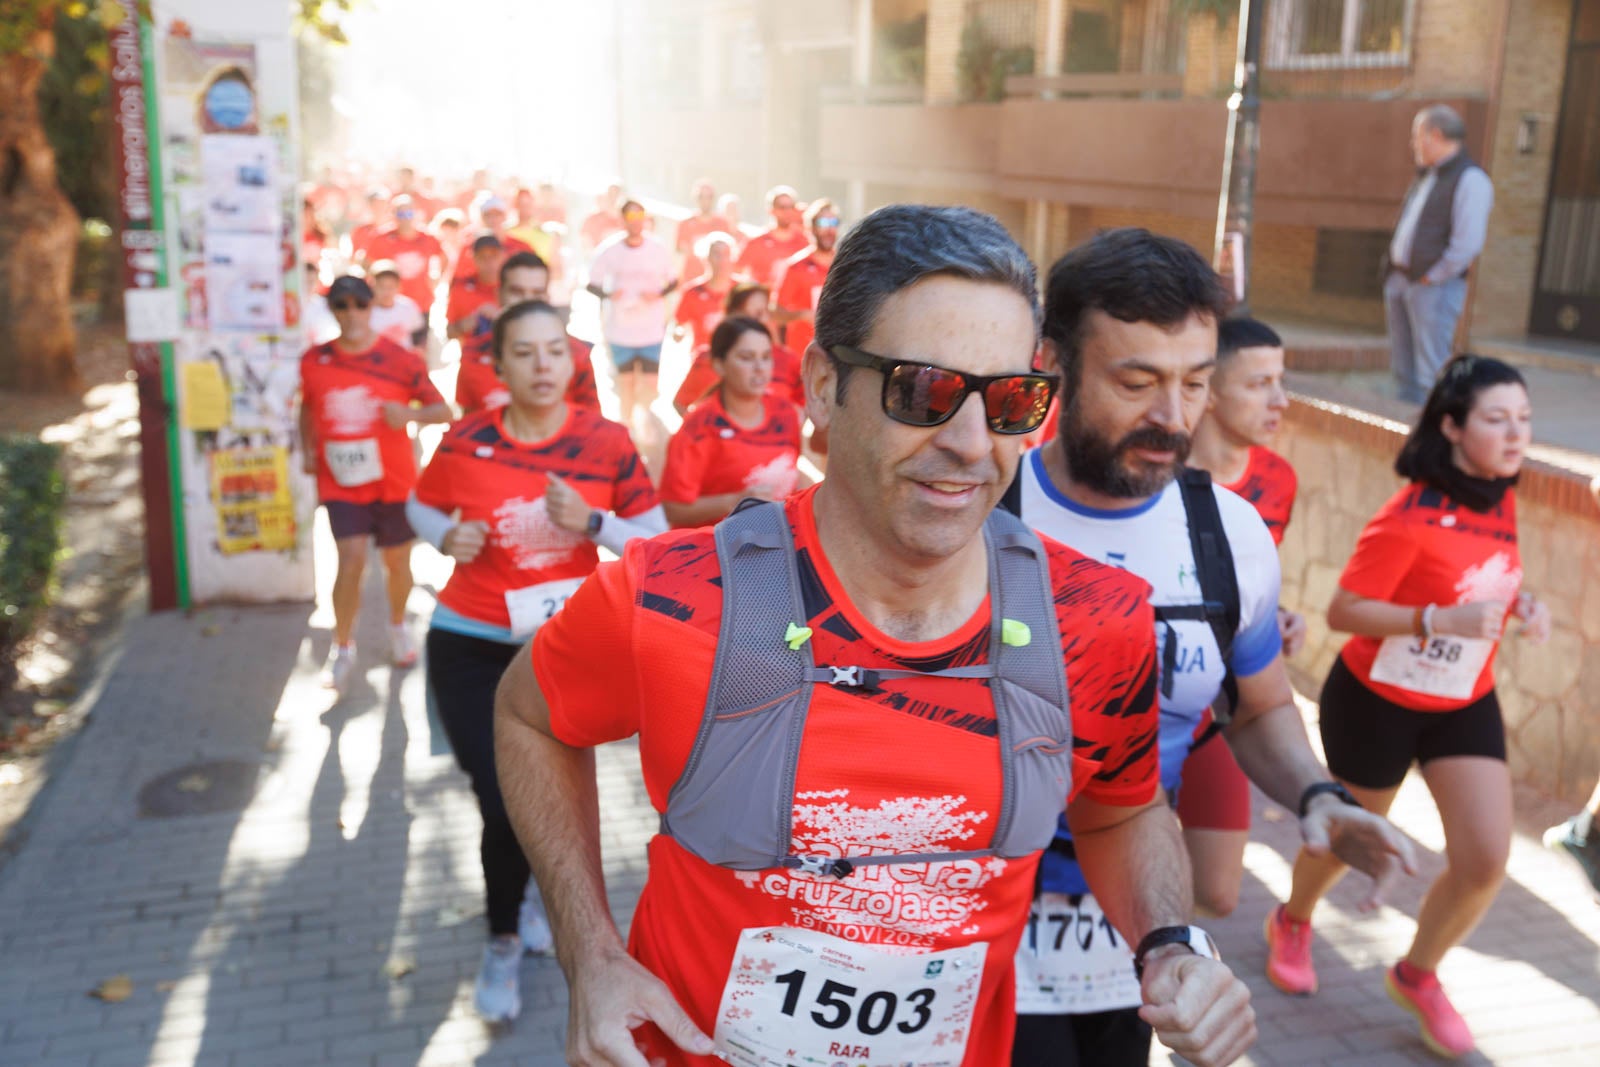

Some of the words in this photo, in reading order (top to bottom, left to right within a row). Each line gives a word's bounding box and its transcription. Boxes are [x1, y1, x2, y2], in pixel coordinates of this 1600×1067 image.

[763, 870, 970, 925] cruzroja.es
[775, 968, 937, 1036] 1503
[828, 1041, 871, 1059] RAFA
